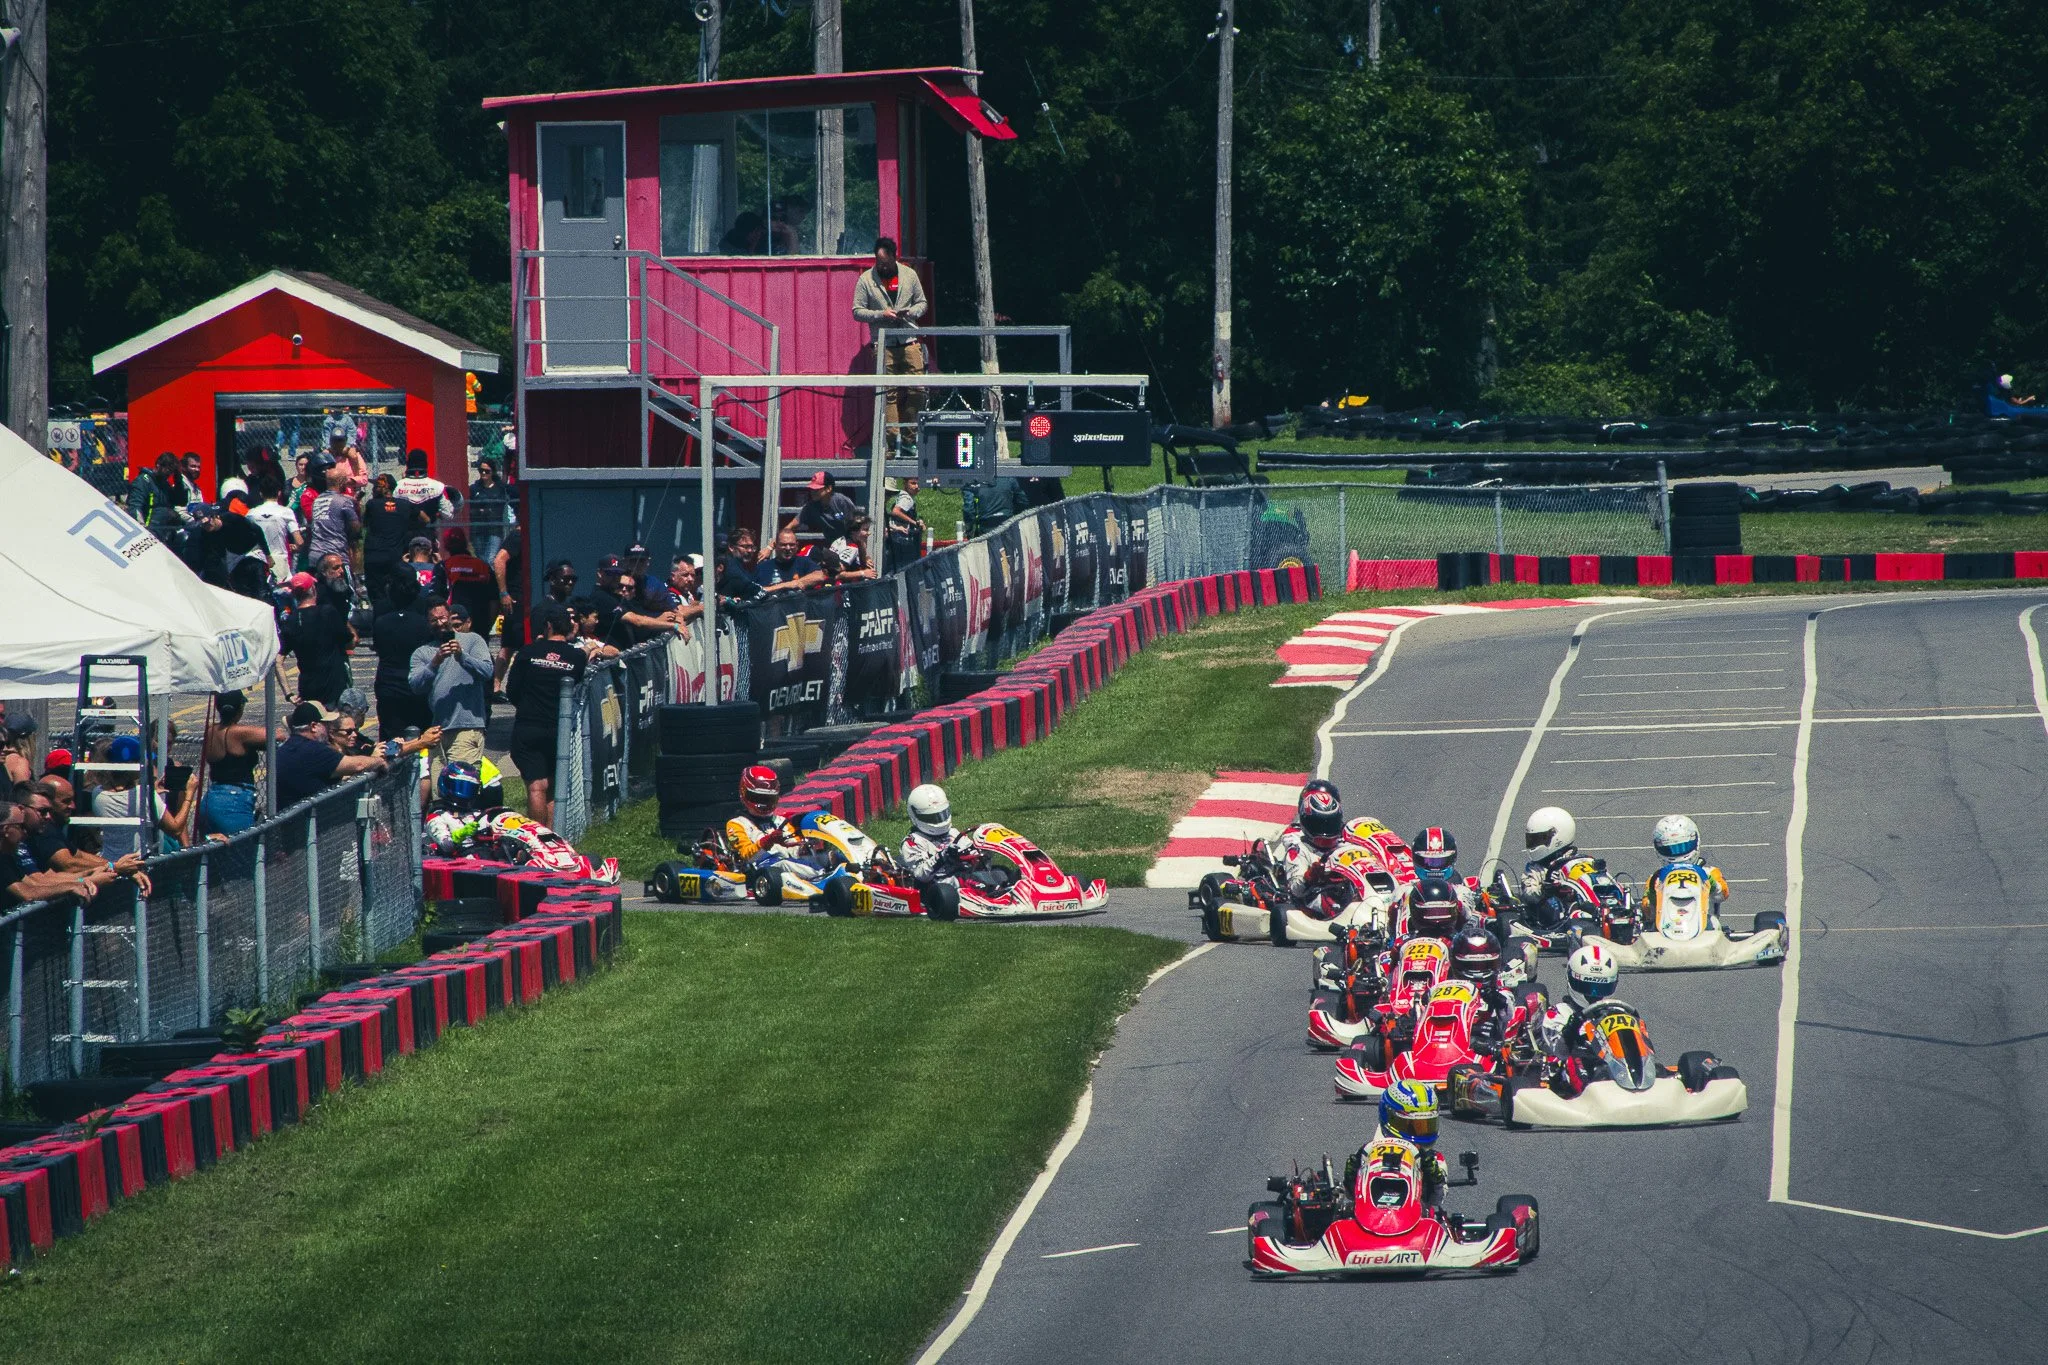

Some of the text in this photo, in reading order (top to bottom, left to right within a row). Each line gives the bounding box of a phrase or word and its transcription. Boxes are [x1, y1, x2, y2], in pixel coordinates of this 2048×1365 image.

[1073, 433, 1124, 442] pixelcom
[1667, 873, 1698, 884] 258
[679, 876, 699, 897] 237
[873, 898, 908, 912] birelART
[1042, 901, 1080, 912] birelART
[1408, 944, 1433, 955] 221
[1433, 986, 1463, 998] 287
[1604, 1015, 1636, 1032] 247
[1377, 1146, 1406, 1157] 217
[1351, 1251, 1420, 1265] birelART
